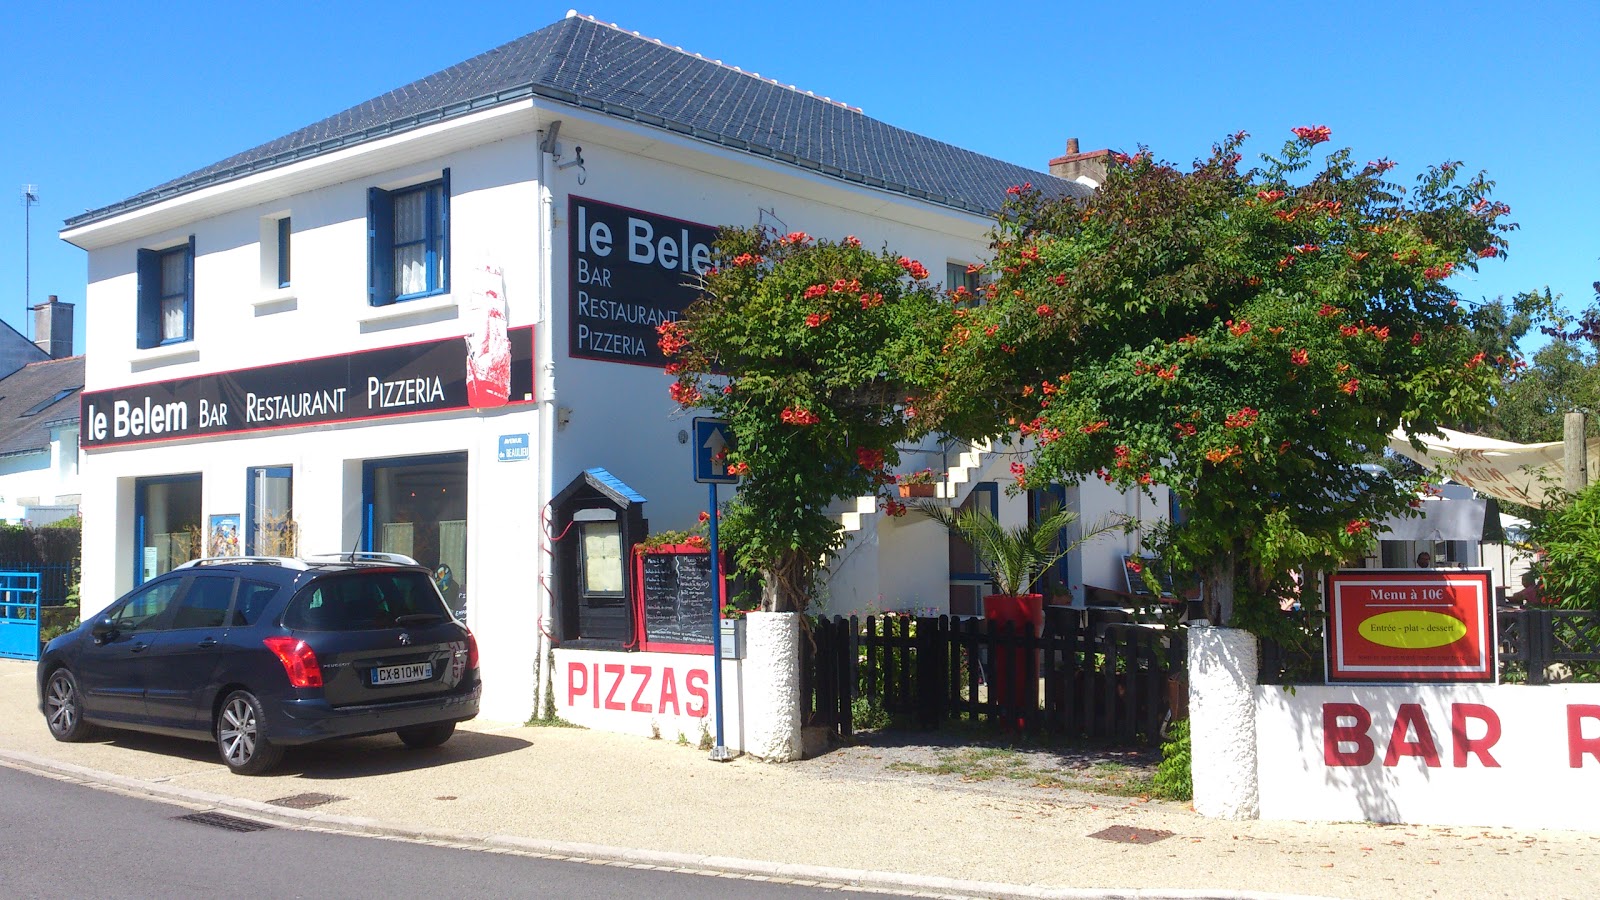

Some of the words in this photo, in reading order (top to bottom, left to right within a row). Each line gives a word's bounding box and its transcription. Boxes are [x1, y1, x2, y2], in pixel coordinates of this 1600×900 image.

[578, 206, 613, 257] le
[628, 217, 721, 276] Bele
[578, 258, 612, 288] BAR
[578, 324, 647, 356] PIZZERIA
[88, 405, 107, 440] le
[114, 397, 188, 438] Belem
[199, 399, 228, 427] BAR
[246, 388, 347, 423] RESTAURANT
[368, 376, 445, 409] PIZZERIA
[506, 447, 528, 457] BEAULIEU
[1370, 589, 1406, 600] Menu
[1410, 589, 1418, 600] à
[1422, 589, 1444, 600] 10€
[1370, 624, 1396, 632] Entrée
[1404, 624, 1419, 633] plat
[1427, 624, 1454, 632] dessert
[379, 665, 424, 681] CX-810-MV
[568, 662, 709, 718] PIZZAS
[1323, 703, 1502, 768] BAR
